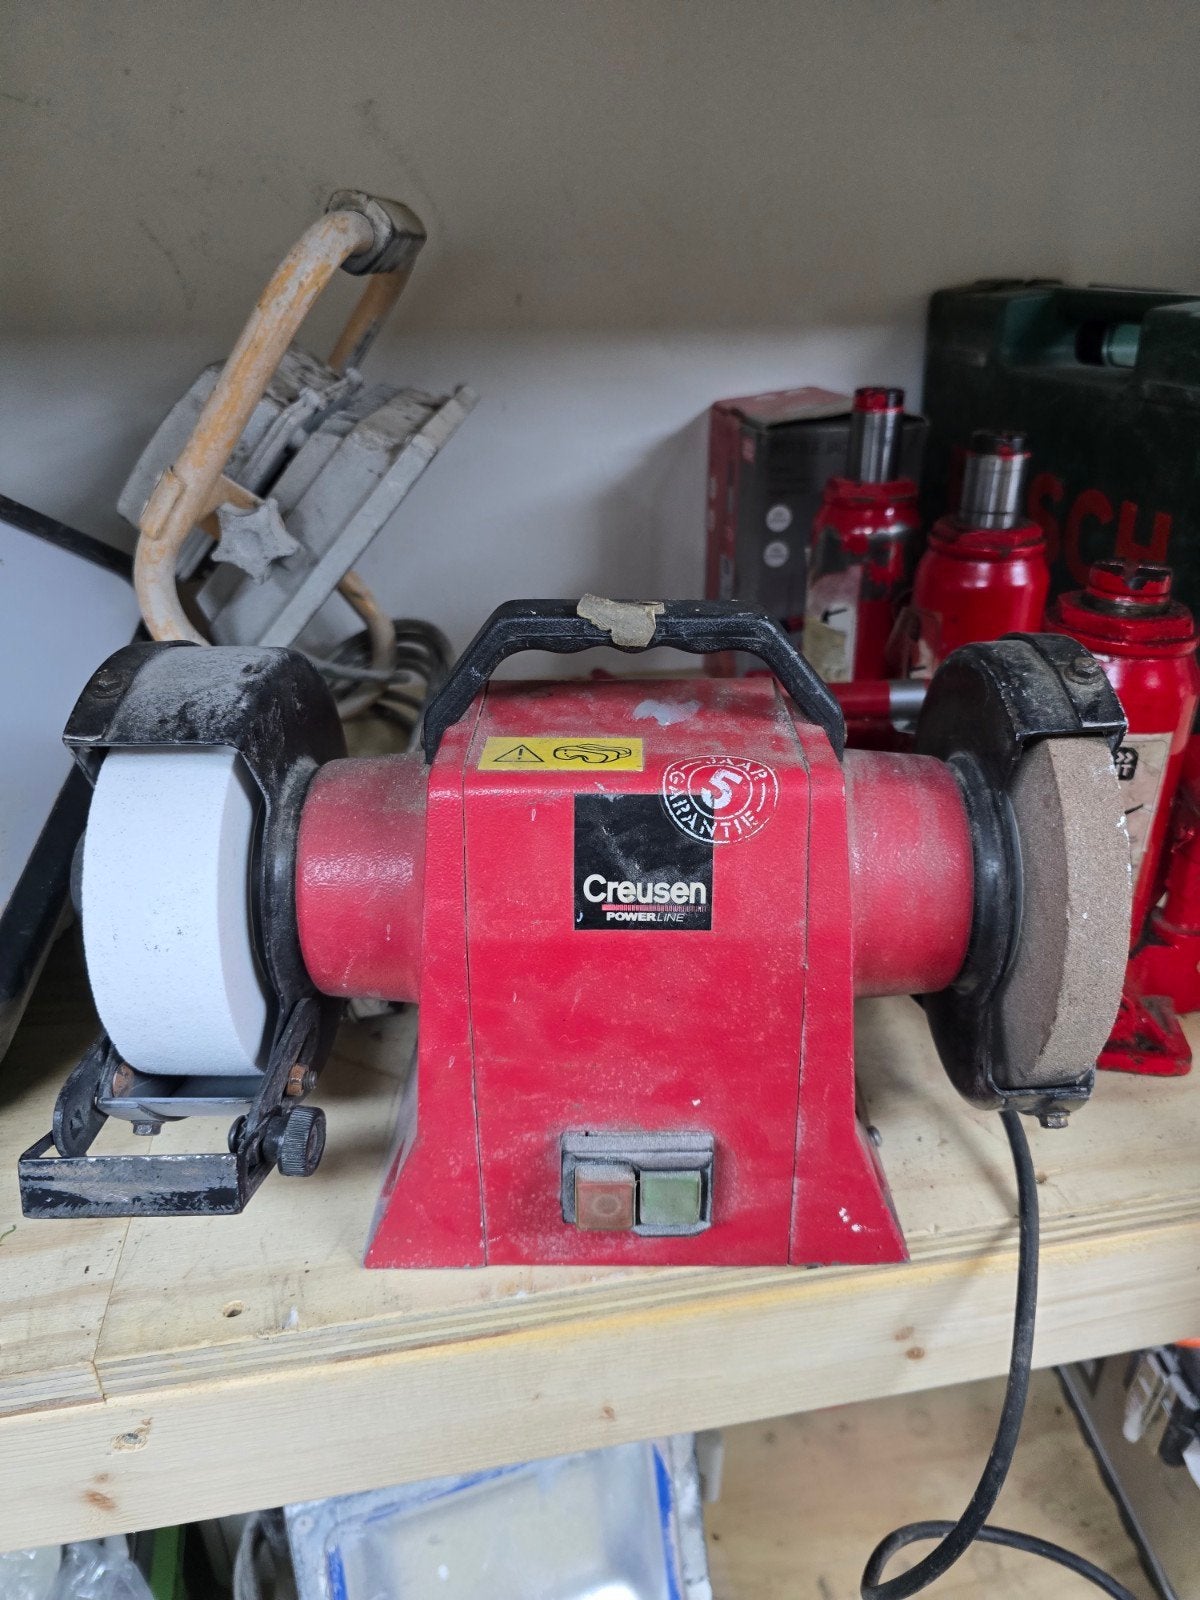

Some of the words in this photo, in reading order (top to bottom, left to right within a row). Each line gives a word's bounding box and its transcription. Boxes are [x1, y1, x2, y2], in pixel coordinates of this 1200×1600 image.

[668, 771, 759, 838] GARANTIE
[701, 768, 743, 810] 5
[583, 874, 706, 904] Creusen
[606, 911, 684, 922] POWERLINE
